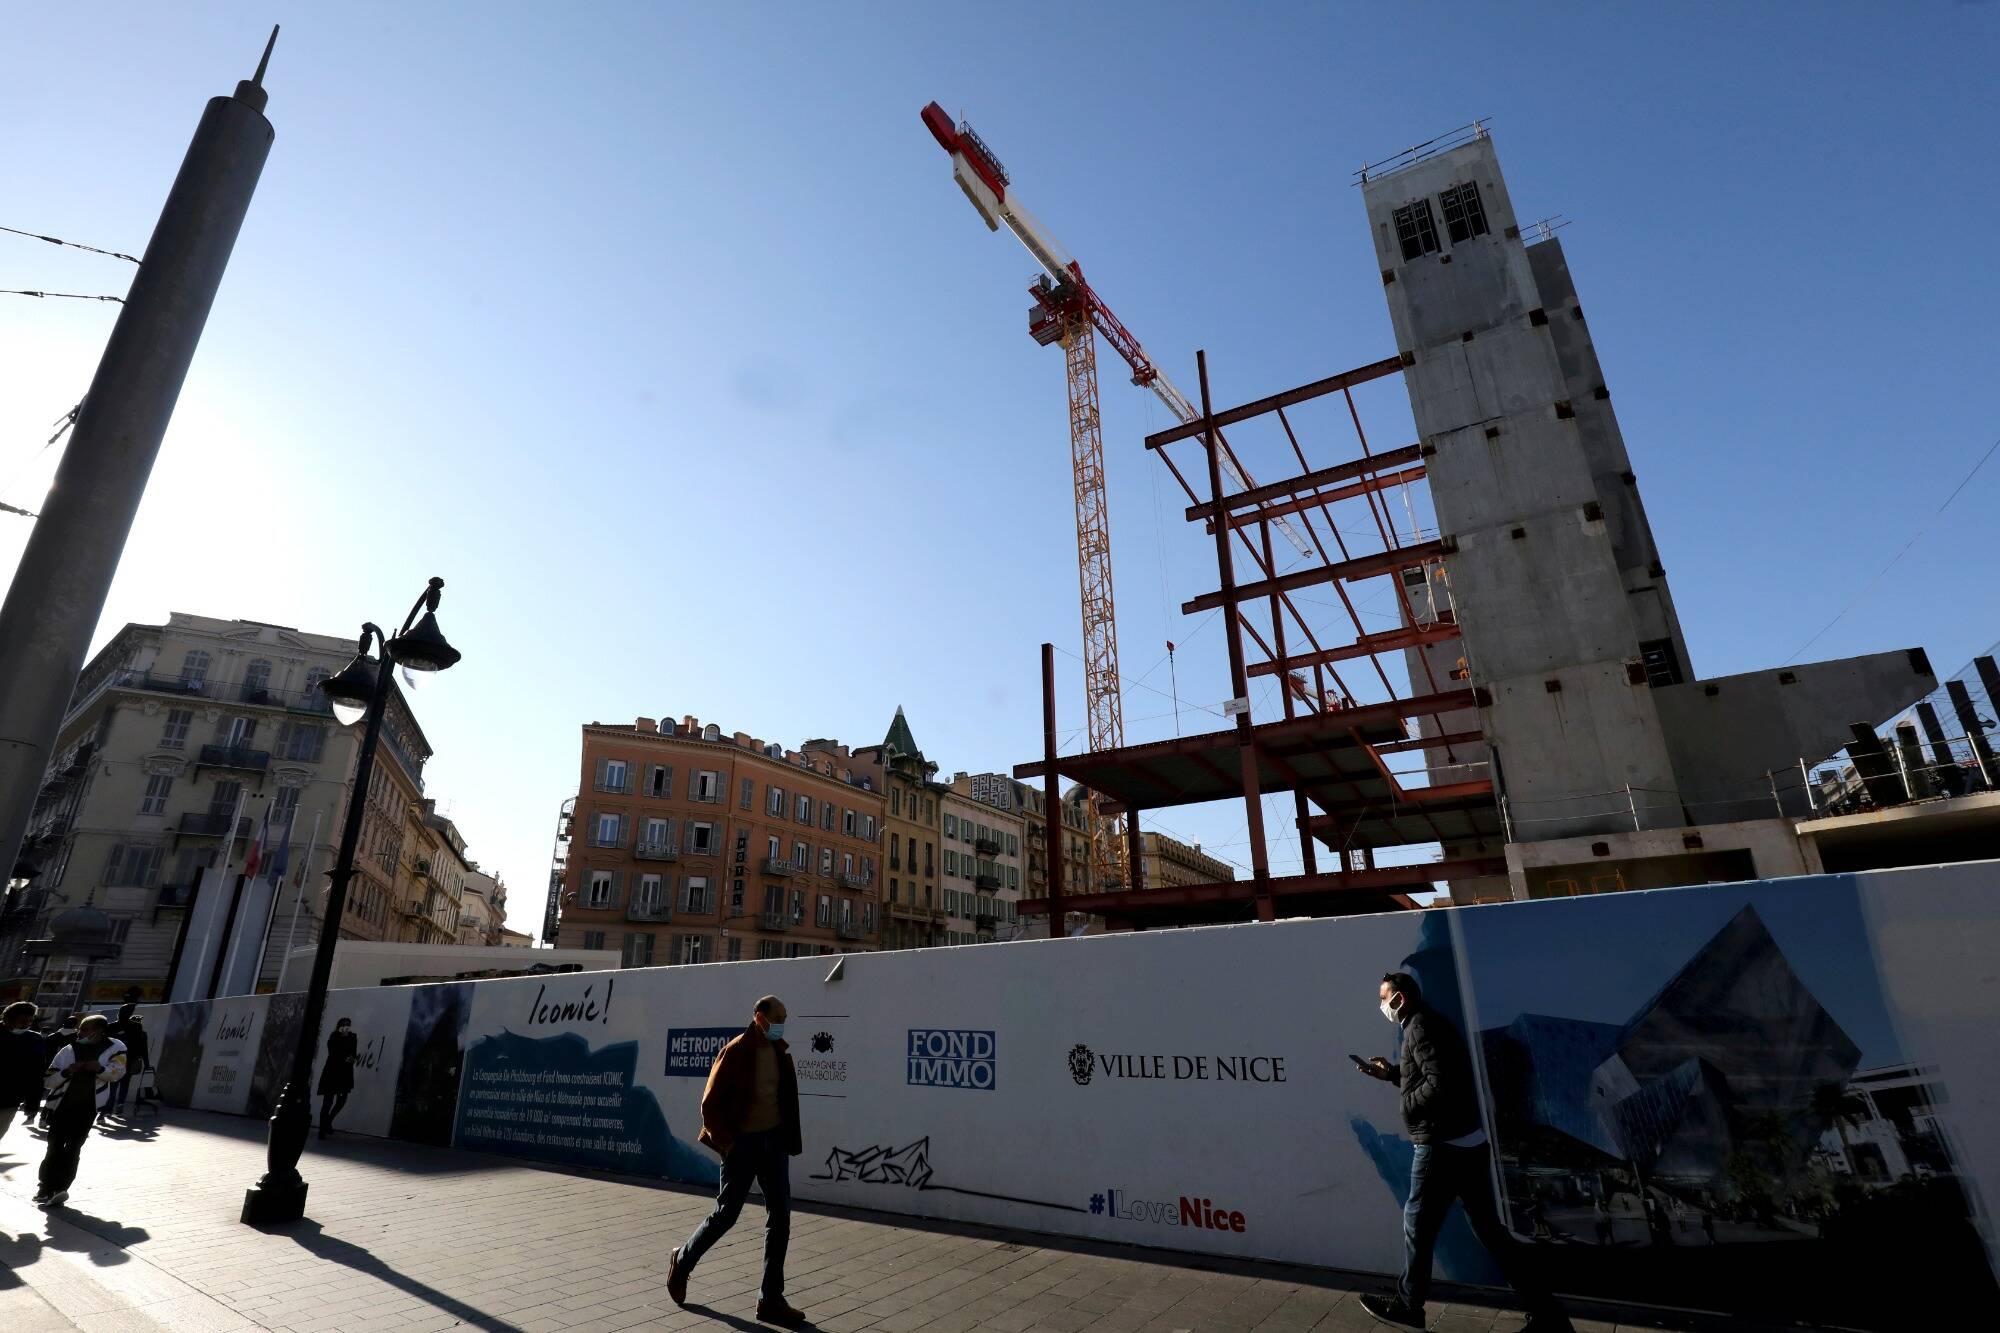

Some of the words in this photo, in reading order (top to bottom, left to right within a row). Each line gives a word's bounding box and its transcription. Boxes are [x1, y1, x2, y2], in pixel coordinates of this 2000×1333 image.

[638, 842, 678, 854] BERNE
[671, 1032, 730, 1053] MÉTROPO
[911, 1031, 993, 1059] FOND
[670, 1056, 688, 1068] NICE
[689, 1053, 710, 1068] CÔTE
[797, 1059, 837, 1071] COMPAGNIE
[838, 1061, 847, 1071] DE
[797, 1069, 847, 1082] PHALSBOURG
[909, 1058, 993, 1088] IMMO
[1098, 1055, 1166, 1080] VILLE
[1173, 1055, 1209, 1081] DE
[1216, 1056, 1288, 1083] NICE
[543, 1070, 556, 1084] Fond
[572, 1072, 602, 1086] construisent
[583, 1096, 596, 1108] pour
[593, 1136, 607, 1150] salle
[1089, 1188, 1246, 1233] #ILoveNice
